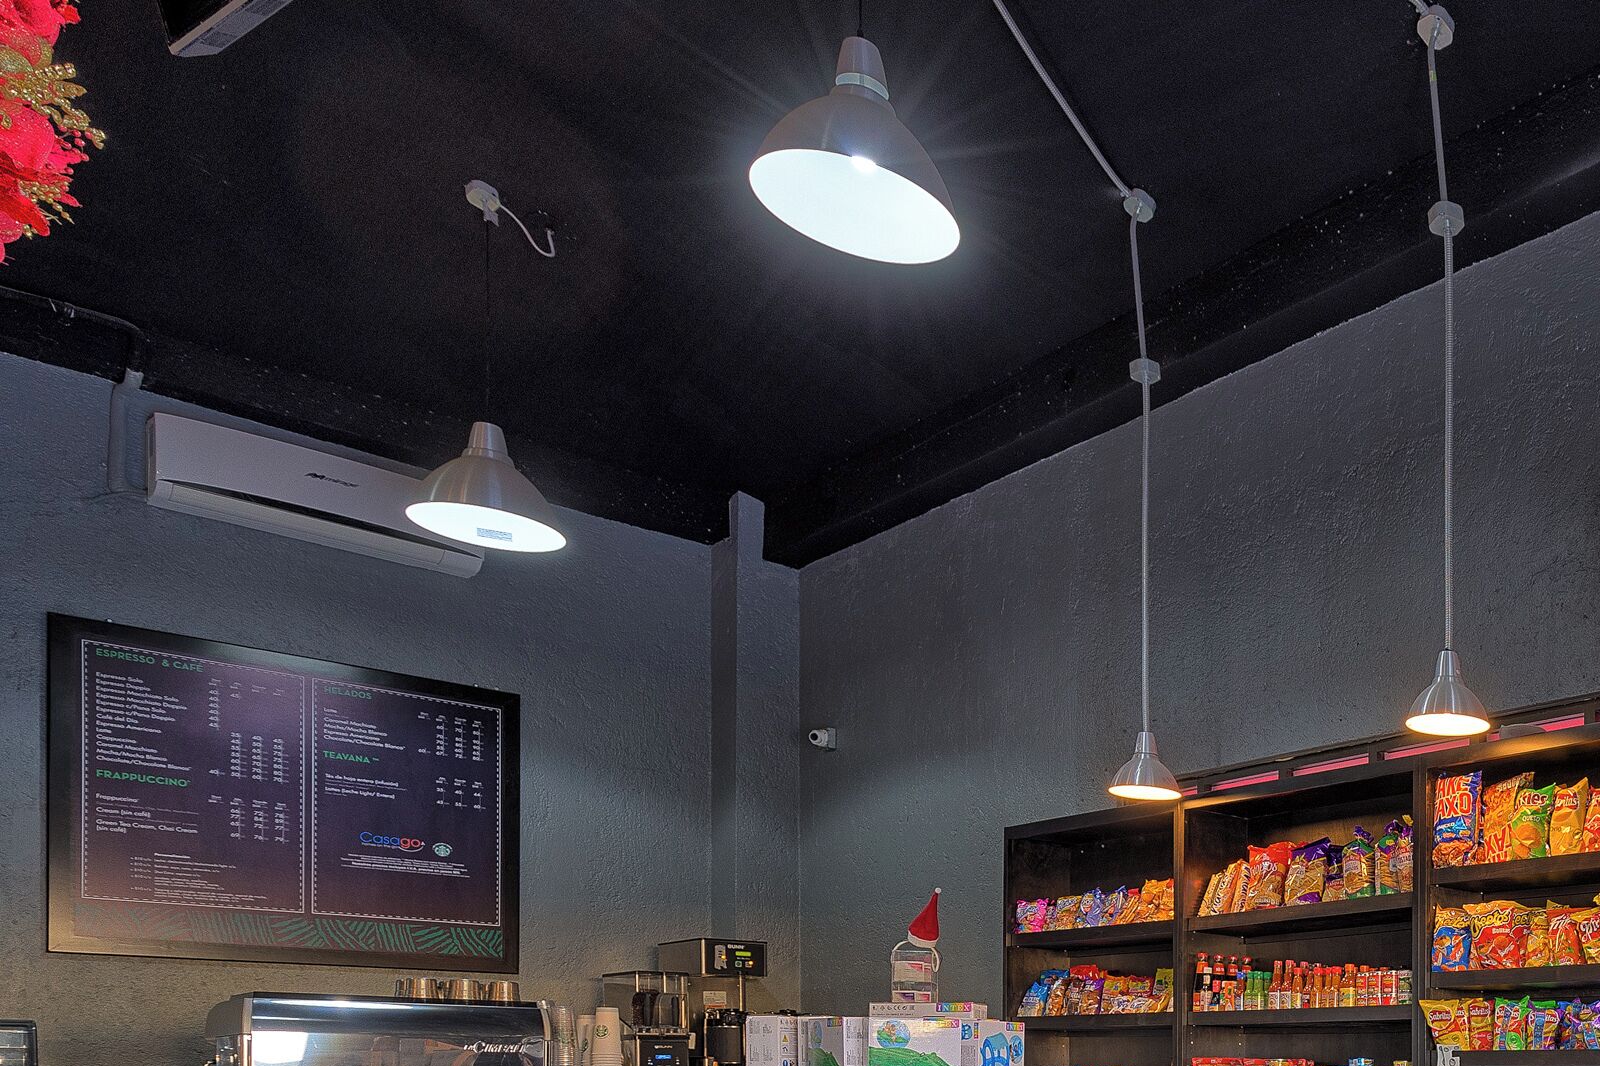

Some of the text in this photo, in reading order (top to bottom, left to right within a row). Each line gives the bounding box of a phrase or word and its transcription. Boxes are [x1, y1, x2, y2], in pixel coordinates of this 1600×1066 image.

[96, 648, 155, 664] ESPRESSO
[161, 659, 169, 667] &
[323, 751, 371, 764] TEAVANA
[937, 1003, 972, 1012] INTEX
